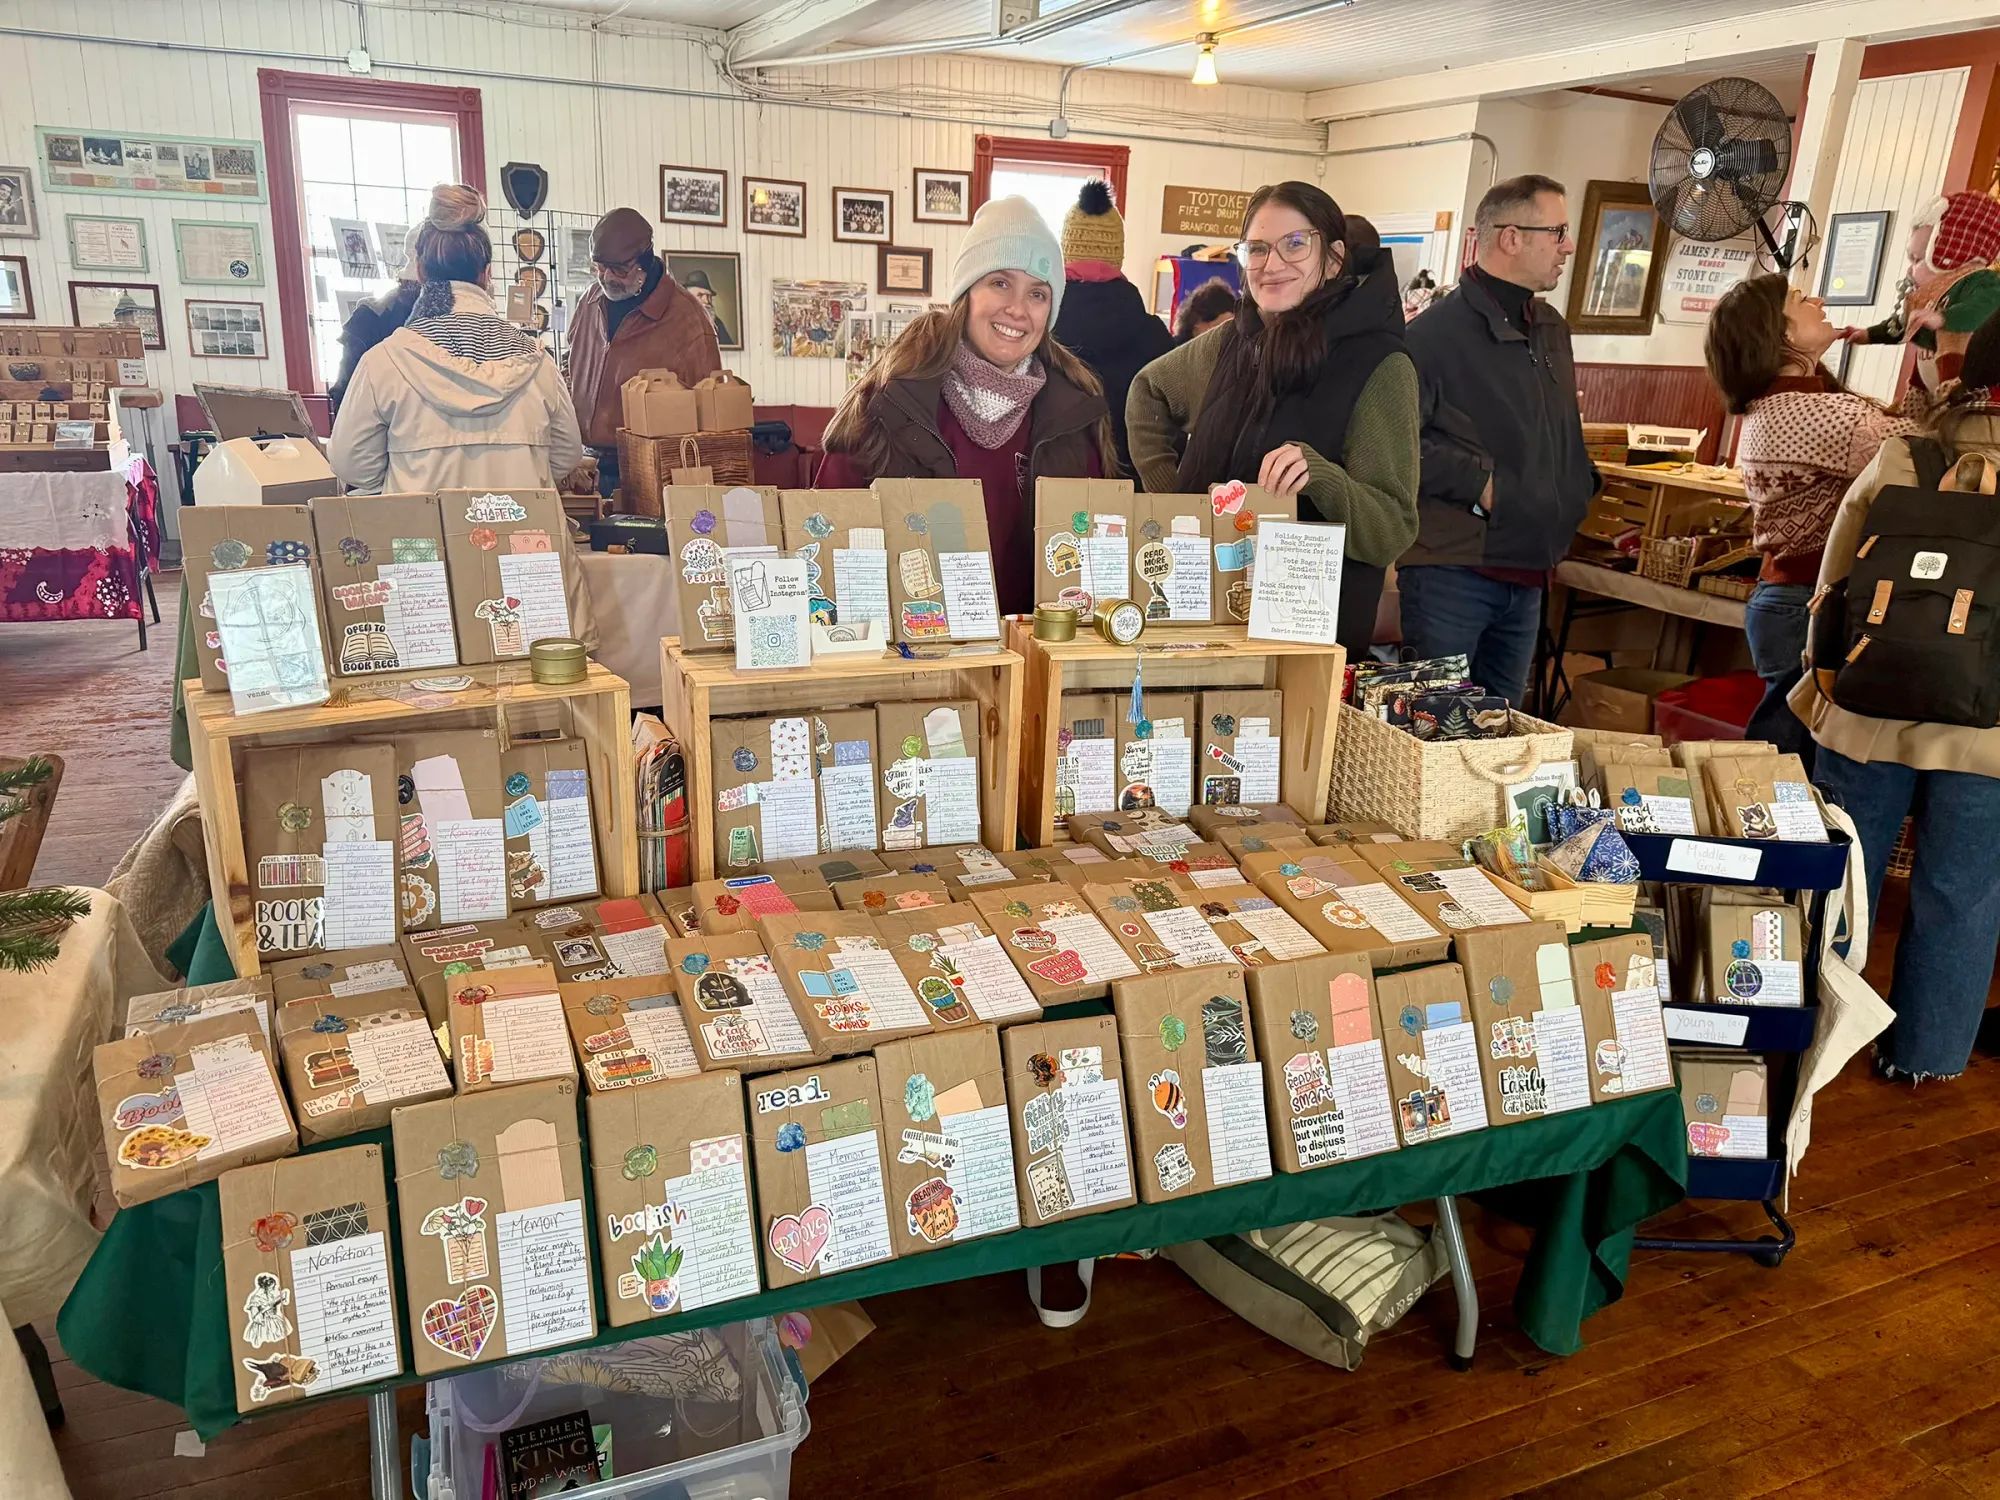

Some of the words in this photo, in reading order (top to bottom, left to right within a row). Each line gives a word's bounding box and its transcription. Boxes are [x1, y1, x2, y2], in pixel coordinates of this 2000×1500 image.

[1178, 205, 1199, 216] FIFE
[1216, 209, 1239, 219] DRUM
[1180, 221, 1219, 234] BRANFORD,
[1679, 245, 1711, 257] JAMES
[1712, 247, 1719, 258] F.
[1722, 249, 1751, 261] KELLY
[1698, 260, 1726, 268] MEMBER
[1677, 268, 1704, 281] STONY
[1214, 485, 1245, 514] Books
[475, 508, 517, 520] CHAPTER
[1275, 532, 1302, 541] Holiday
[1144, 549, 1163, 559] READ
[1276, 545, 1311, 554] paperback
[1144, 556, 1166, 567] MORE
[1300, 559, 1317, 567] Bags
[1144, 565, 1168, 575] BOOKS
[1288, 565, 1316, 573] Candles
[687, 573, 725, 583] PEOPLE
[334, 586, 368, 598] BOOKS
[1278, 582, 1306, 590] Sleeves
[1291, 607, 1330, 615] Bookmarks
[347, 624, 372, 635] OPEN
[374, 624, 386, 633] TO
[343, 660, 371, 672] BOOK
[375, 659, 400, 670] RECS
[246, 690, 270, 698] venmo
[1126, 745, 1146, 753] Sorry
[1207, 745, 1212, 753] I
[1221, 754, 1245, 773] BOOKS
[887, 769, 908, 781] FAIRY
[1618, 804, 1651, 815] read
[523, 818, 540, 828] READING
[1623, 814, 1655, 823] more
[1625, 823, 1661, 833] books
[1142, 845, 1189, 855] BOOK
[258, 899, 325, 923] BOOKS
[258, 925, 276, 950] &
[280, 923, 325, 949] TEA
[423, 944, 465, 955] BOOKS
[468, 939, 491, 948] ARE
[435, 949, 483, 961] MAGIC
[1034, 951, 1076, 970] emotional
[573, 961, 623, 981] read
[1044, 961, 1078, 977] support
[1056, 969, 1084, 982] kindle
[826, 1002, 863, 1016] BOOKS
[716, 1024, 752, 1037] Read
[836, 1020, 868, 1030] WORLD
[363, 1027, 416, 1042] Romance
[728, 1034, 751, 1043] BOOKS
[1696, 1030, 1728, 1042] adult
[714, 1037, 764, 1051] Change
[605, 1051, 628, 1060] LIKE
[599, 1080, 626, 1089] READ
[631, 1073, 667, 1084] BOOKS
[1288, 1067, 1325, 1089] READING
[1500, 1069, 1548, 1096] Easily
[558, 1084, 572, 1094] $15
[305, 1101, 317, 1109] IN
[321, 1093, 340, 1104] MY
[1292, 1086, 1334, 1112] smart
[1504, 1101, 1520, 1113] Cats
[1525, 1098, 1548, 1112] Books
[310, 1105, 334, 1115] ERA
[1292, 1110, 1345, 1128] introverted
[1031, 1119, 1070, 1153] READING
[1296, 1128, 1310, 1141] but
[1312, 1123, 1345, 1141] willing
[945, 1137, 960, 1148] DOGS
[1298, 1143, 1307, 1154] to
[1309, 1136, 1346, 1152] discuss
[829, 1149, 866, 1164] Memoir
[1309, 1150, 1337, 1164] books
[913, 1181, 943, 1201] READING
[938, 1208, 949, 1217] my
[512, 1212, 564, 1238] Memoir
[779, 1217, 828, 1254] BOOKS
[308, 1244, 374, 1274] Nonfiction
[841, 1257, 853, 1266] and
[378, 1288, 388, 1296] the
[542, 1288, 575, 1302] heritage
[350, 1303, 362, 1312] the
[531, 1312, 541, 1321] the
[579, 1299, 586, 1313] of
[547, 1320, 584, 1334] traditions
[507, 1417, 585, 1447] STEPHEN
[512, 1437, 589, 1473] KING
[511, 1478, 537, 1494] END
[554, 1461, 595, 1479] WATCH
